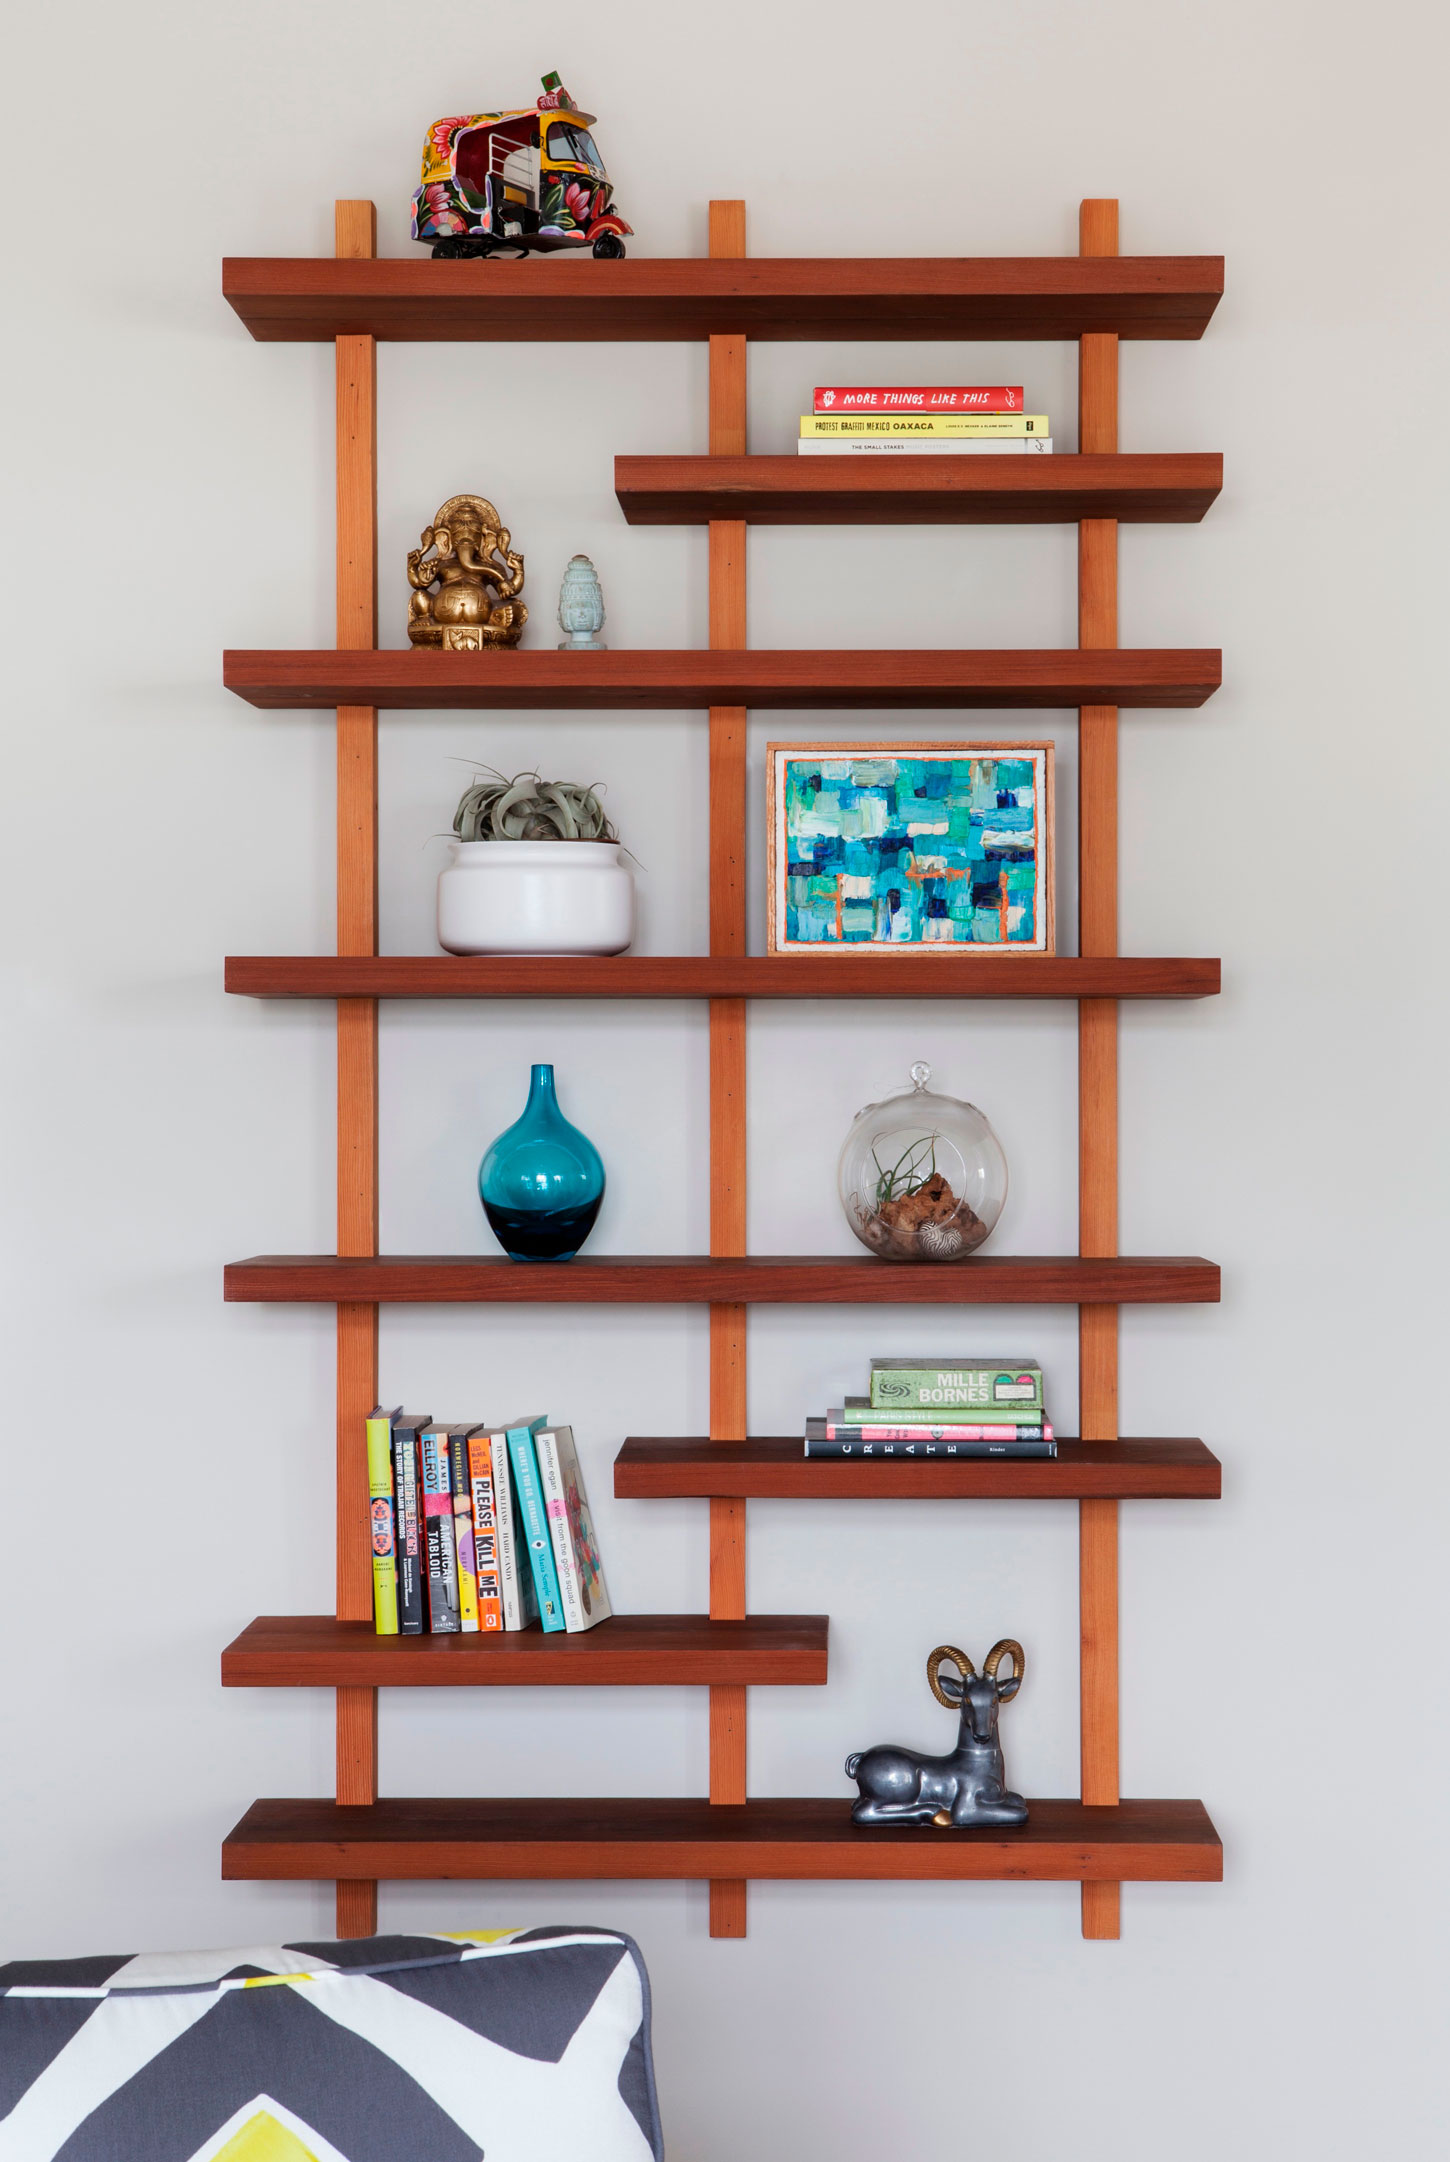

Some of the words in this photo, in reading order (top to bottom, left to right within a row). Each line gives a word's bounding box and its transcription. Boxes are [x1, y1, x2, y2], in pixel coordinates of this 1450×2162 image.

[843, 392, 877, 405] MORE
[883, 392, 925, 406] THINGS
[931, 392, 958, 405] LIKE
[962, 392, 991, 405] THIS
[815, 421, 839, 431] PROTEST
[840, 421, 865, 431] GRAFFITI
[866, 421, 890, 431] MEXICO
[893, 422, 934, 430] OAXACA
[936, 1373, 989, 1387] MILLE
[918, 1388, 989, 1402] BORNES
[395, 1441, 403, 1453] THE
[543, 1438, 555, 1468] jennifer
[842, 1444, 957, 1454] CREATE
[423, 1439, 438, 1490] ELLROY
[454, 1442, 463, 1480] NORWEGIAN
[397, 1475, 403, 1484] OF
[522, 1474, 532, 1487] YOU
[548, 1470, 557, 1491] egan
[397, 1485, 405, 1510] TROJAN
[475, 1480, 493, 1528] PLEASE
[554, 1504, 563, 1522] visit
[398, 1510, 406, 1540] RECORDS
[557, 1522, 565, 1541] from
[428, 1530, 441, 1578] TABLOID
[439, 1524, 453, 1584] AMERICAN
[475, 1535, 495, 1570] KILL
[502, 1532, 510, 1554] HARD
[504, 1555, 512, 1581] CANDY
[561, 1558, 571, 1578] goon
[479, 1575, 498, 1598] ME
[565, 1580, 576, 1605] squad
